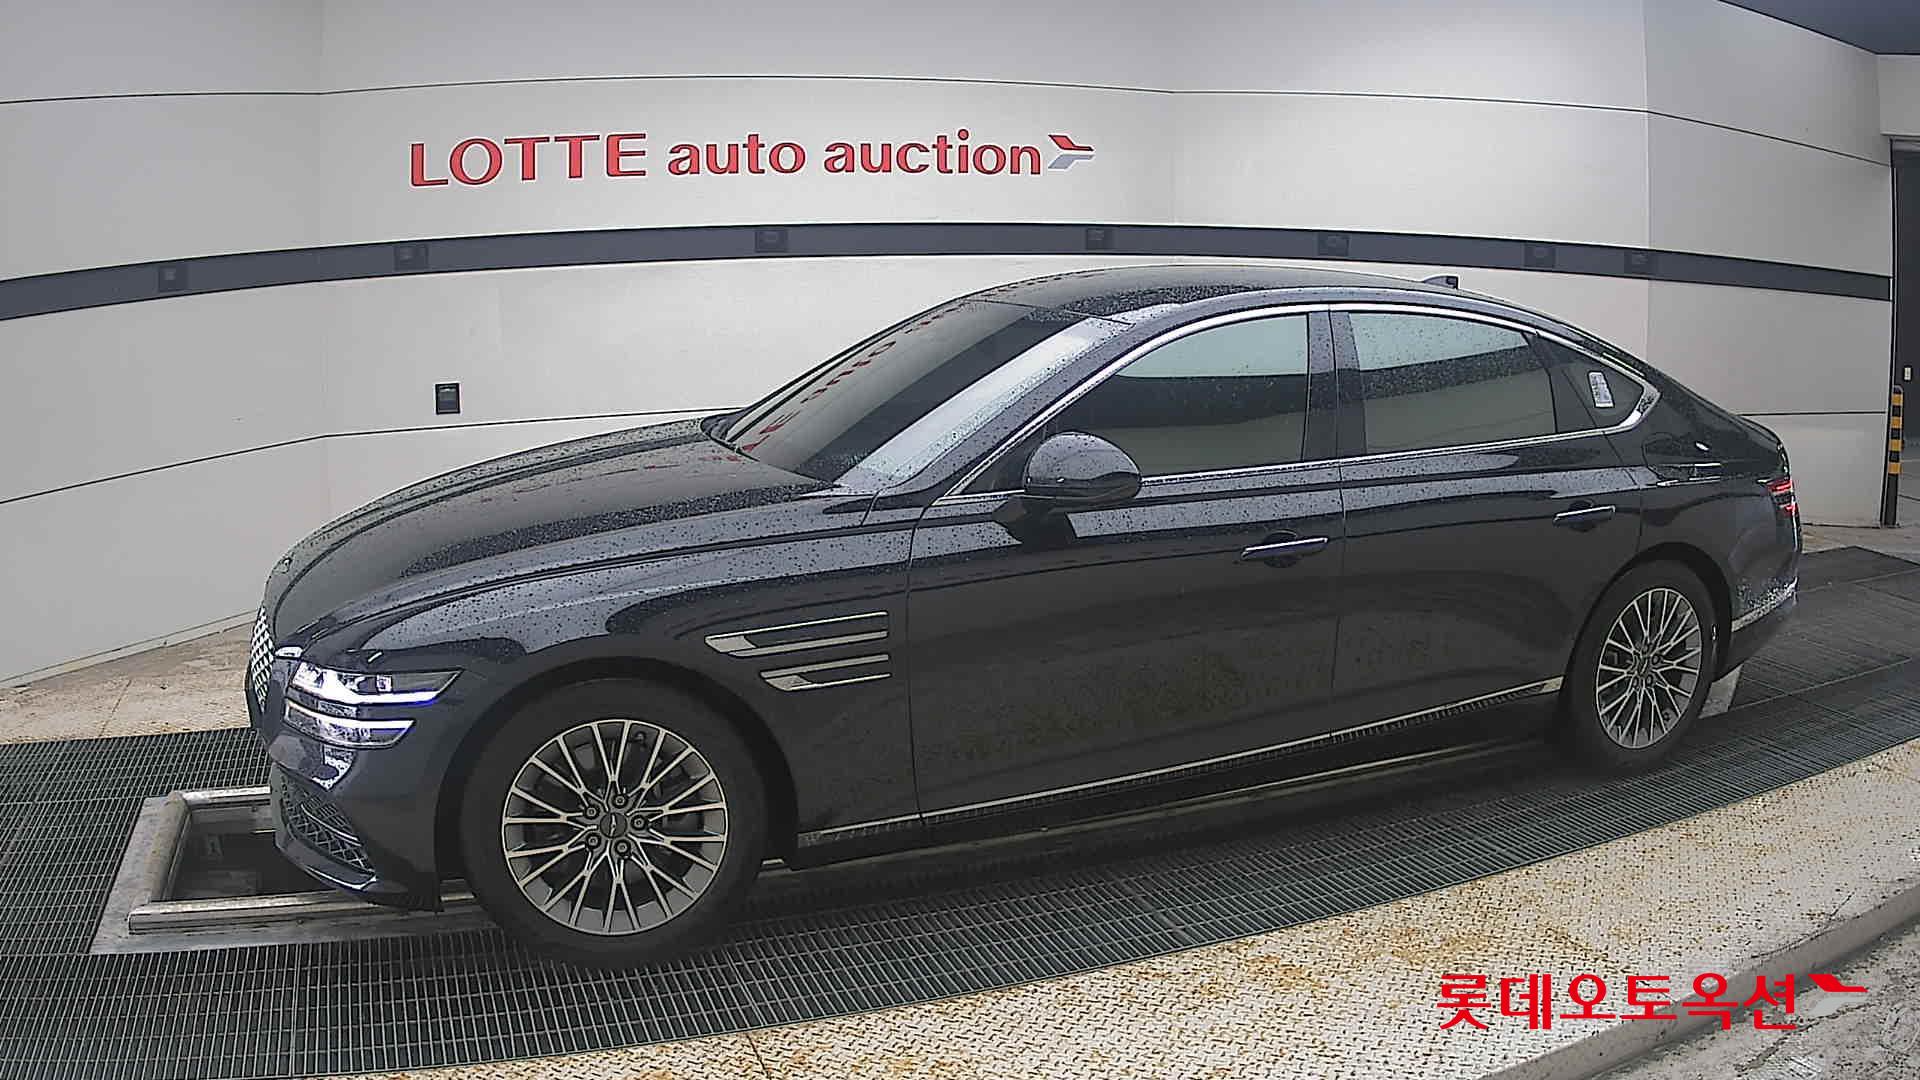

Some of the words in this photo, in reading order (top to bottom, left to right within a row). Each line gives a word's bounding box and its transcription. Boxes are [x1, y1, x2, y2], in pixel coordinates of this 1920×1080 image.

[410, 133, 647, 188] LOTTE
[667, 133, 806, 175] auto
[824, 128, 1041, 176] auction
